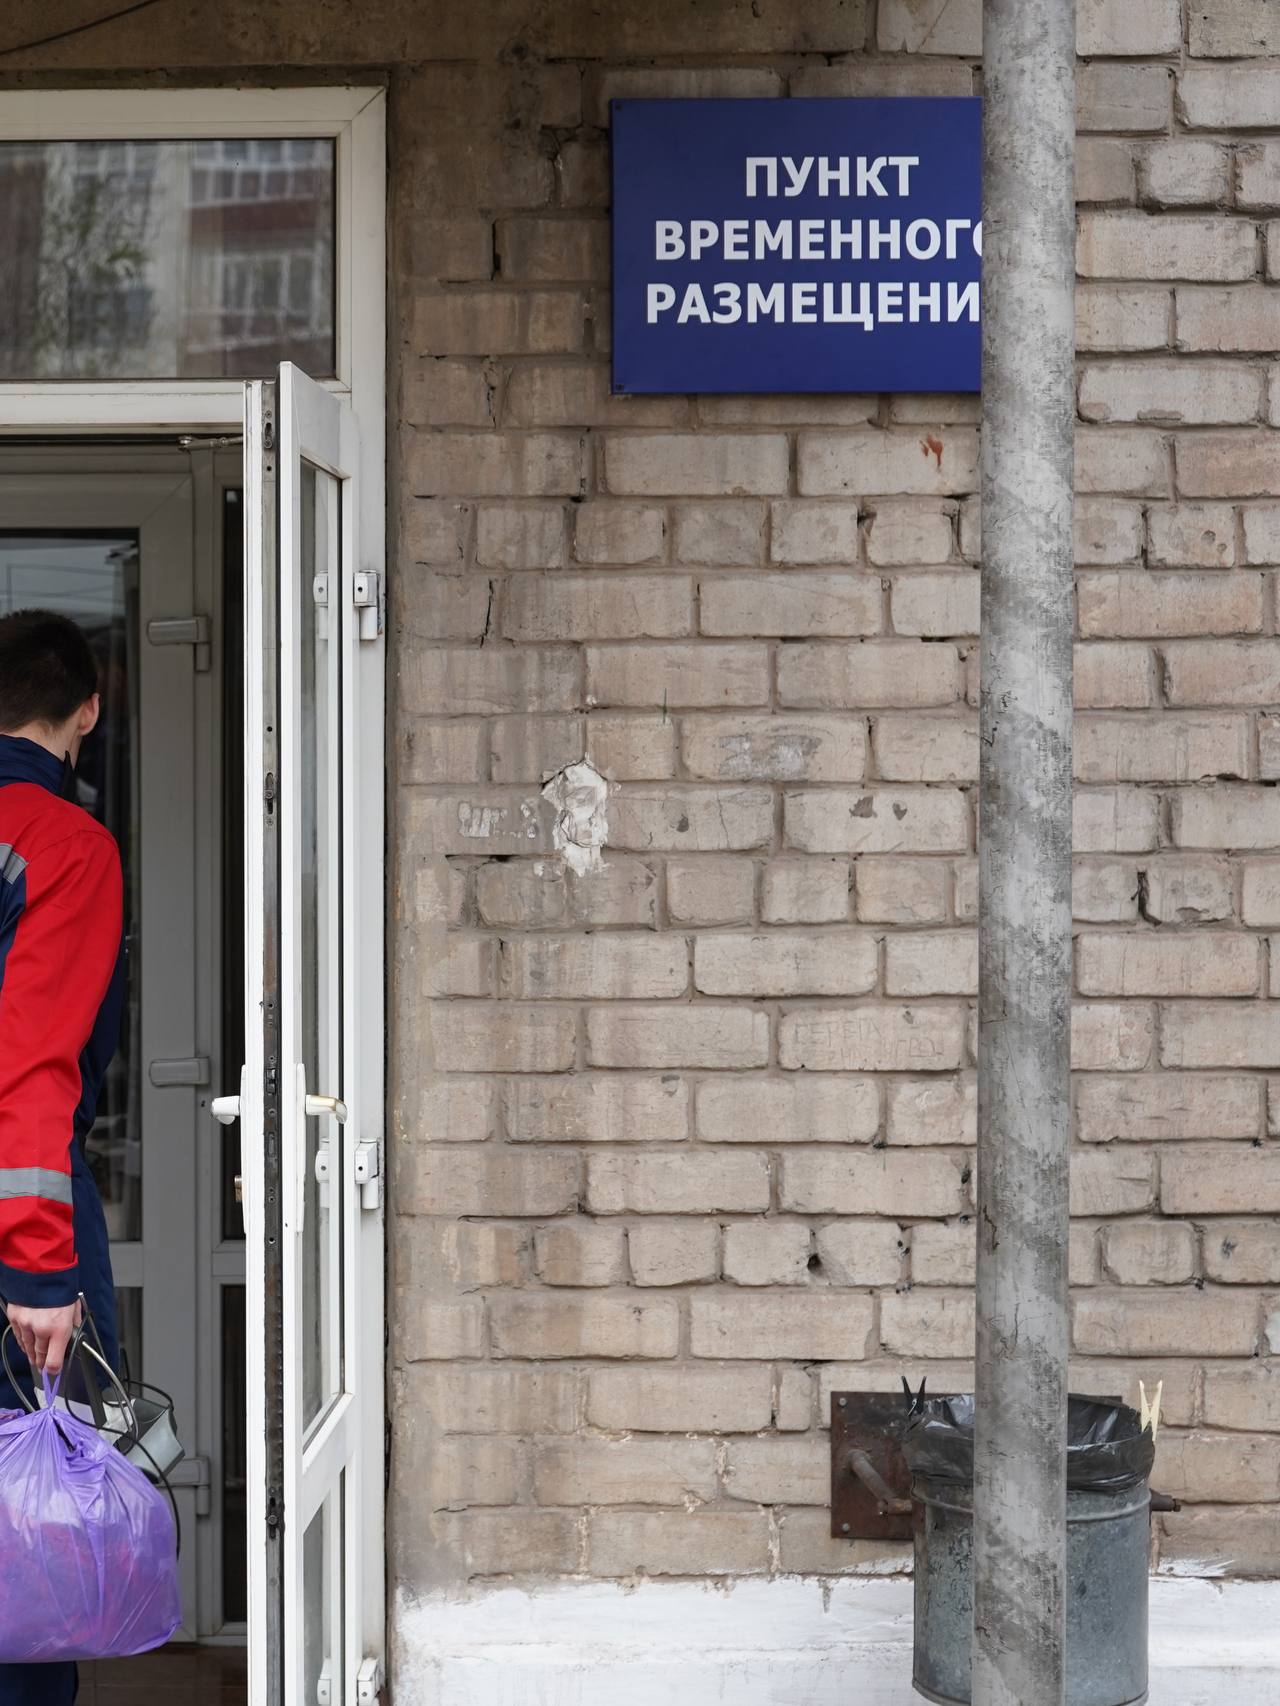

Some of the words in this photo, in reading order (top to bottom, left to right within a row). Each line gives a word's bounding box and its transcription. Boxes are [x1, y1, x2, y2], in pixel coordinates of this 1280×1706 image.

[745, 156, 920, 198] ПУНКТ
[655, 218, 982, 261] ВРЕМЕННОГ
[646, 281, 981, 331] РАЗМЕЩЕНИ
